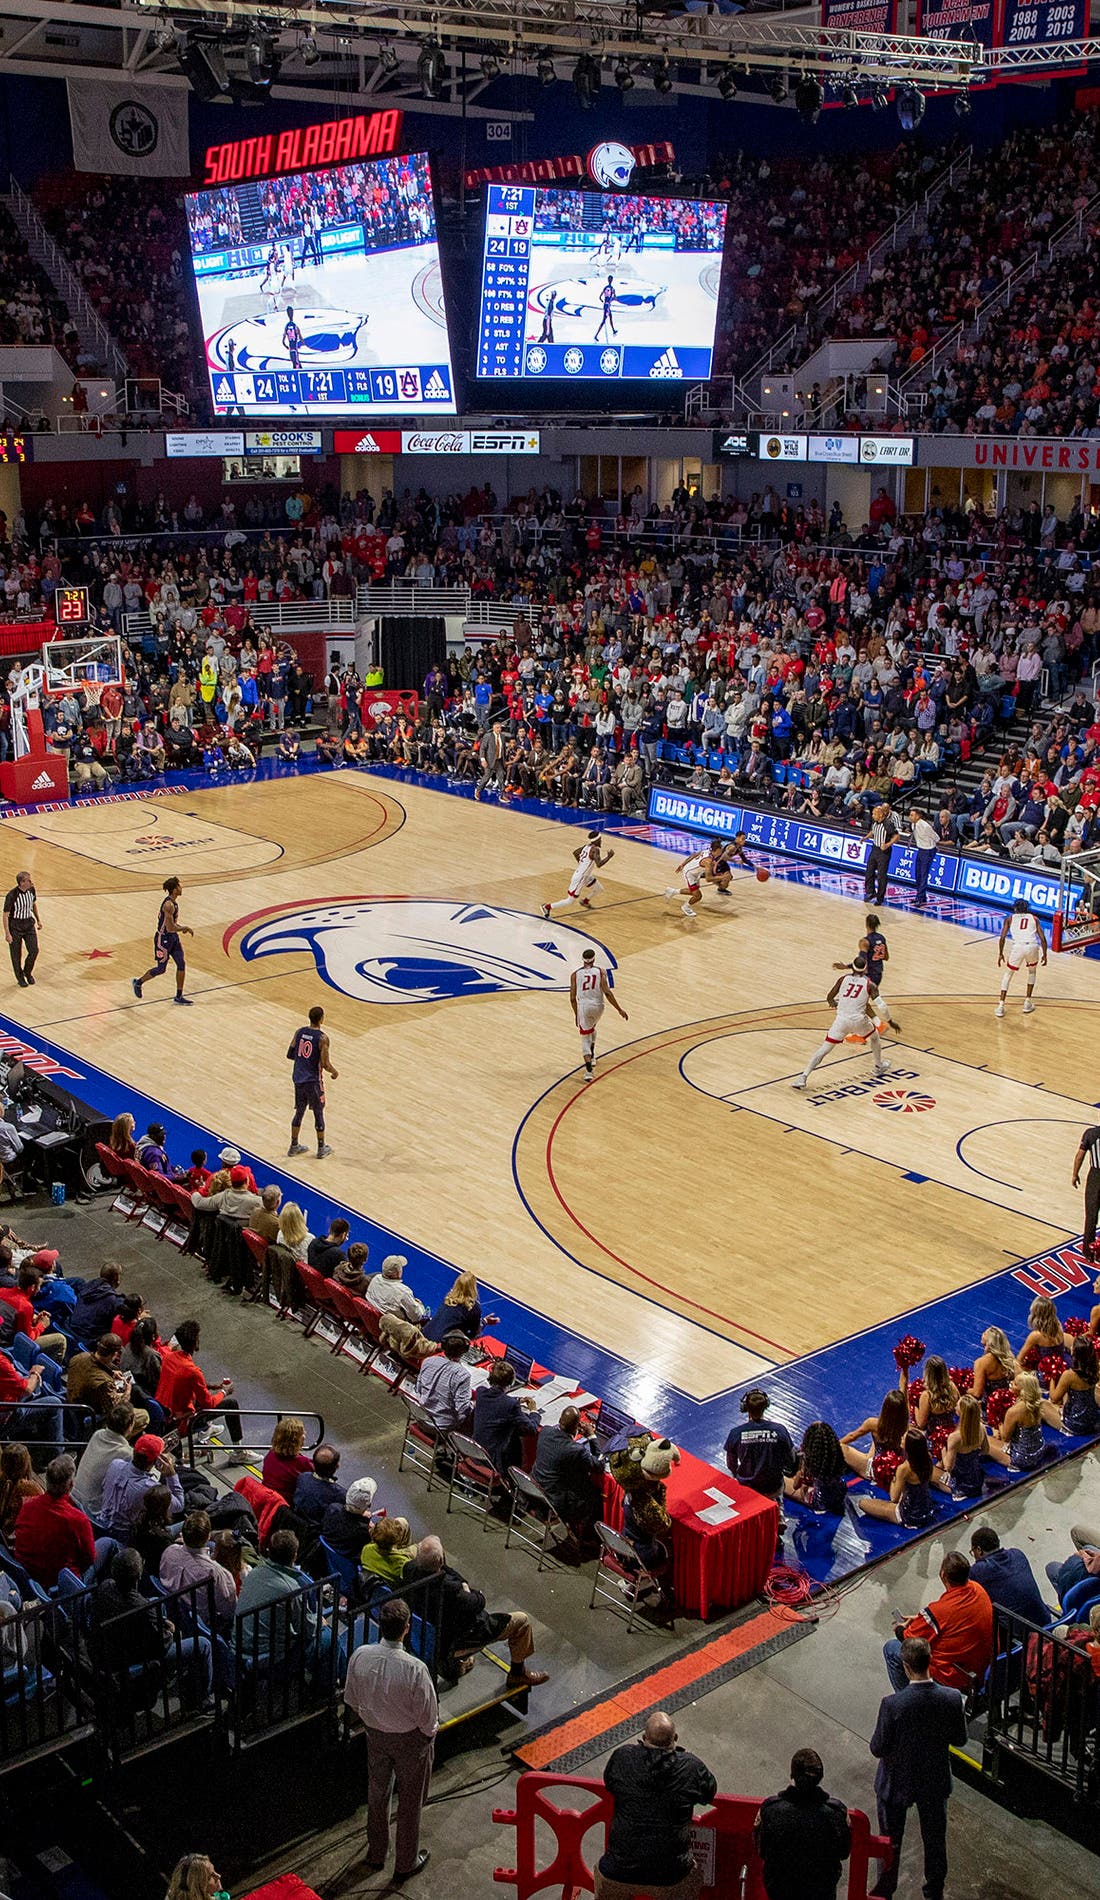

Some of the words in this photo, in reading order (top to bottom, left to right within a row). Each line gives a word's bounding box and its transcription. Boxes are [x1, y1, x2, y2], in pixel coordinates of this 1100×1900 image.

[829, 2, 855, 13] WOMEN'S
[827, 6, 888, 28] CONFERENCE
[922, 3, 990, 28] TOURNAMENT
[1012, 9, 1038, 26] 1988
[1047, 5, 1075, 21] 2003
[928, 27, 951, 40] 1987
[1008, 25, 1037, 41] 2004
[1045, 20, 1074, 37] 2019
[488, 125, 510, 138] 304
[203, 135, 272, 185] SOUTH
[275, 109, 399, 172] ALABAMA
[501, 187, 523, 201] 7:21
[505, 202, 518, 210] 1ST
[490, 240, 505, 253] 24
[513, 242, 526, 254] 19
[499, 264, 515, 272] FG%
[495, 343, 509, 351] AST
[494, 368, 507, 376] FLS
[650, 366, 683, 378] adidas
[257, 379, 273, 398] 24
[307, 372, 333, 391] 7:21
[375, 375, 394, 396] 19
[424, 388, 450, 400] adidas
[272, 432, 314, 441] COOK'S
[407, 433, 464, 452] Coca-Cola
[880, 446, 898, 456] CART
[64, 590, 84, 601] 7:21
[62, 601, 81, 619] 23
[31, 781, 56, 791] adidas
[35, 785, 189, 814] ALABAMA
[656, 796, 689, 818] BUD
[689, 805, 736, 830] LIGHT
[755, 815, 764, 823] FT
[771, 819, 777, 828] 2
[785, 822, 790, 831] 2
[747, 832, 761, 842] FG%
[751, 823, 763, 833] 3PT
[783, 831, 788, 840] 1
[803, 833, 818, 848] 24
[904, 849, 914, 859] FT
[899, 858, 913, 868] 3PT
[895, 867, 911, 878] FG%
[965, 867, 1011, 895] BUD
[1011, 879, 1078, 912] LIGHT
[1020, 918, 1029, 930] 0
[582, 974, 597, 991] 21
[843, 983, 863, 998] 33
[297, 1038, 313, 1059] 10
[860, 1068, 920, 1088] SUN
[806, 1085, 871, 1107] BELT
